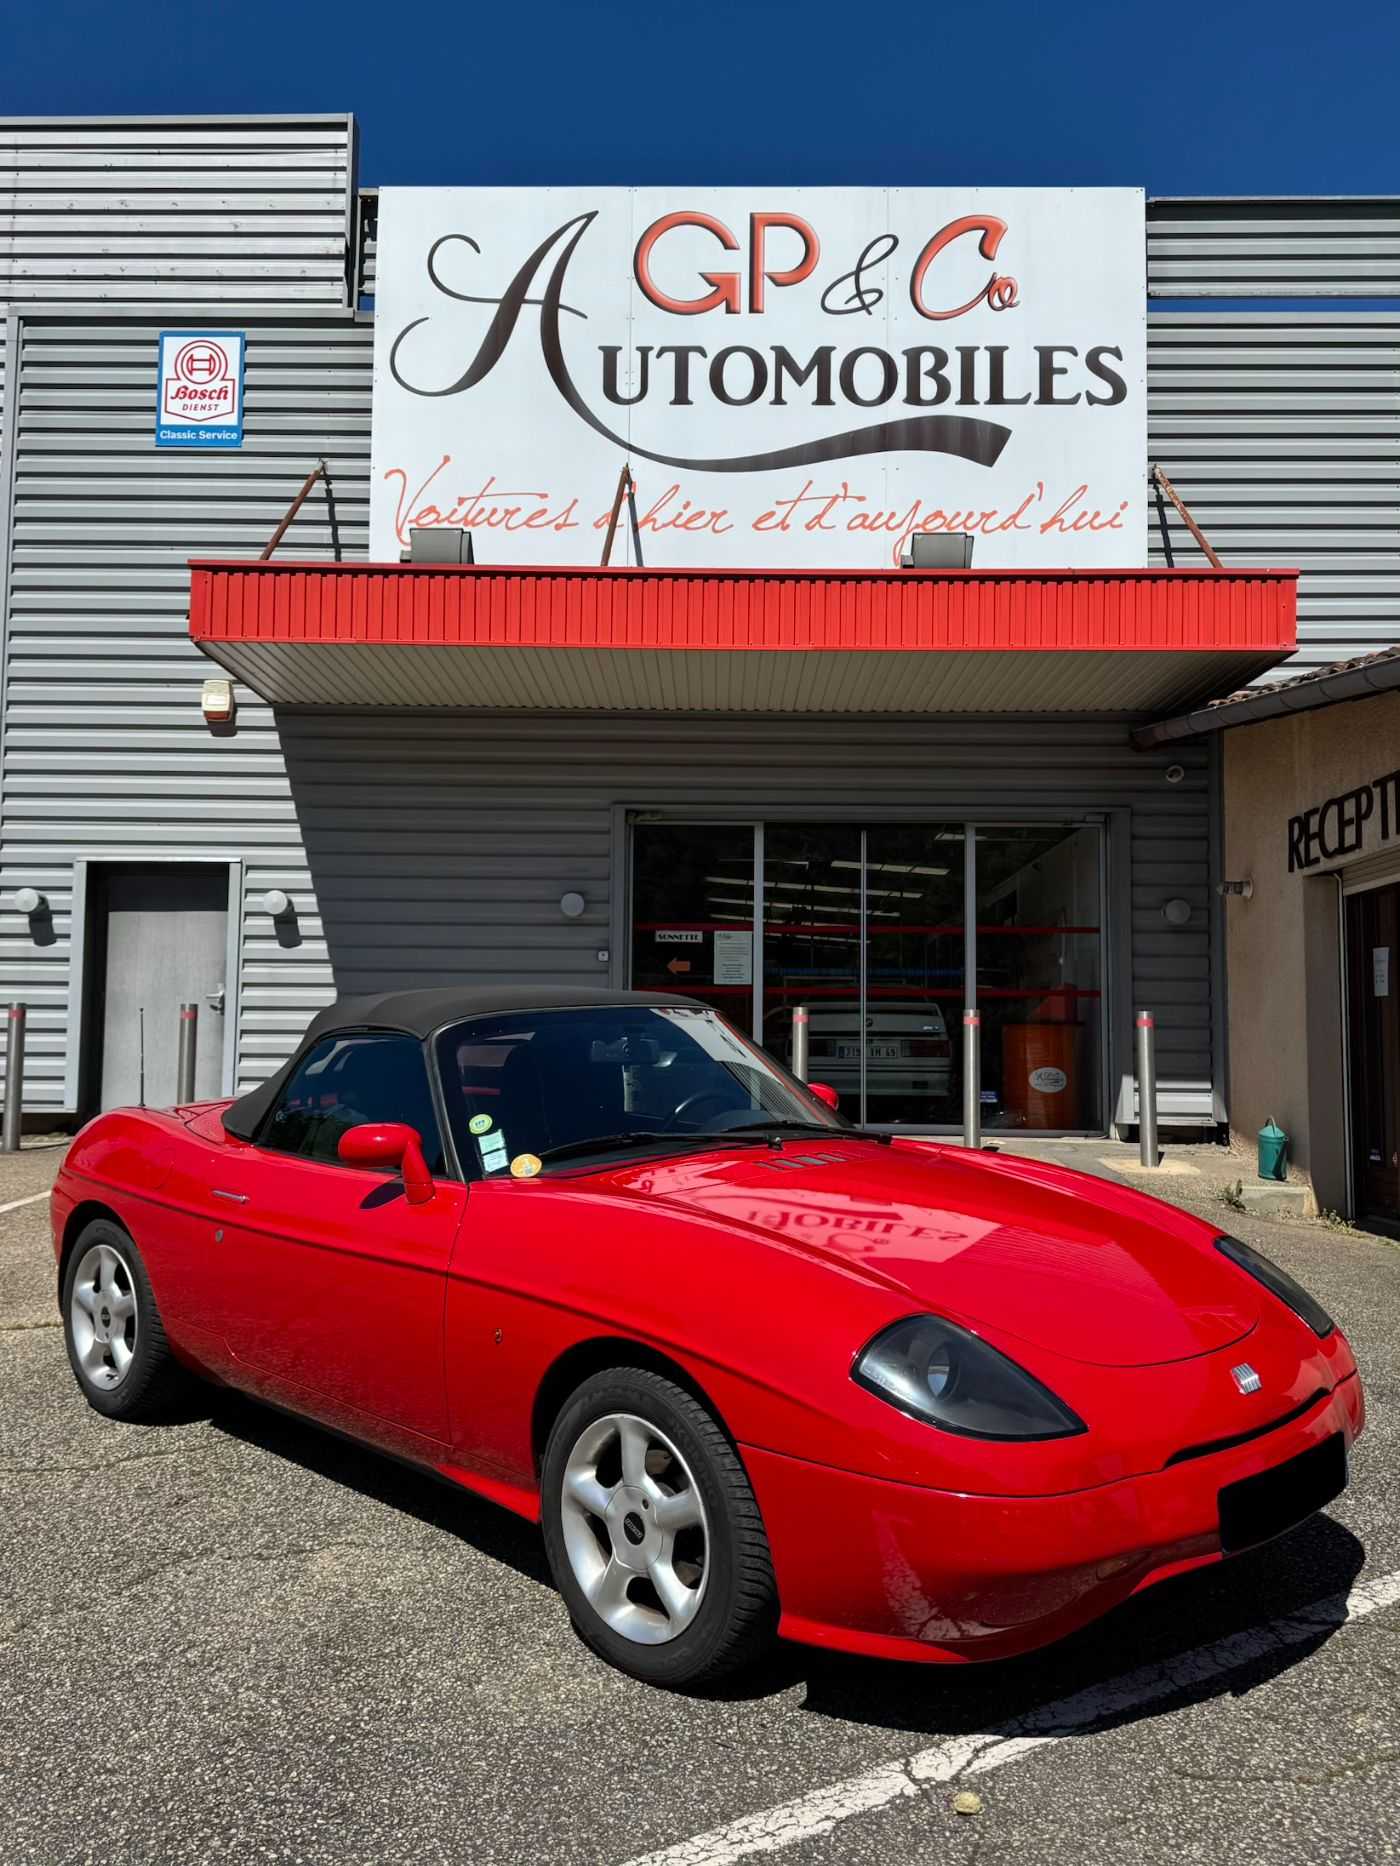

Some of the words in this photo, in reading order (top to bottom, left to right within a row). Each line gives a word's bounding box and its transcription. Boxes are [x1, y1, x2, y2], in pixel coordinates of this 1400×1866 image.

[633, 210, 820, 315] GP
[820, 233, 899, 316] &
[909, 214, 1021, 321] Co
[170, 385, 229, 400] Bosch
[182, 403, 219, 411] DIENST
[159, 430, 197, 440] Classic
[199, 431, 238, 440] Service
[384, 454, 579, 546] Voitures
